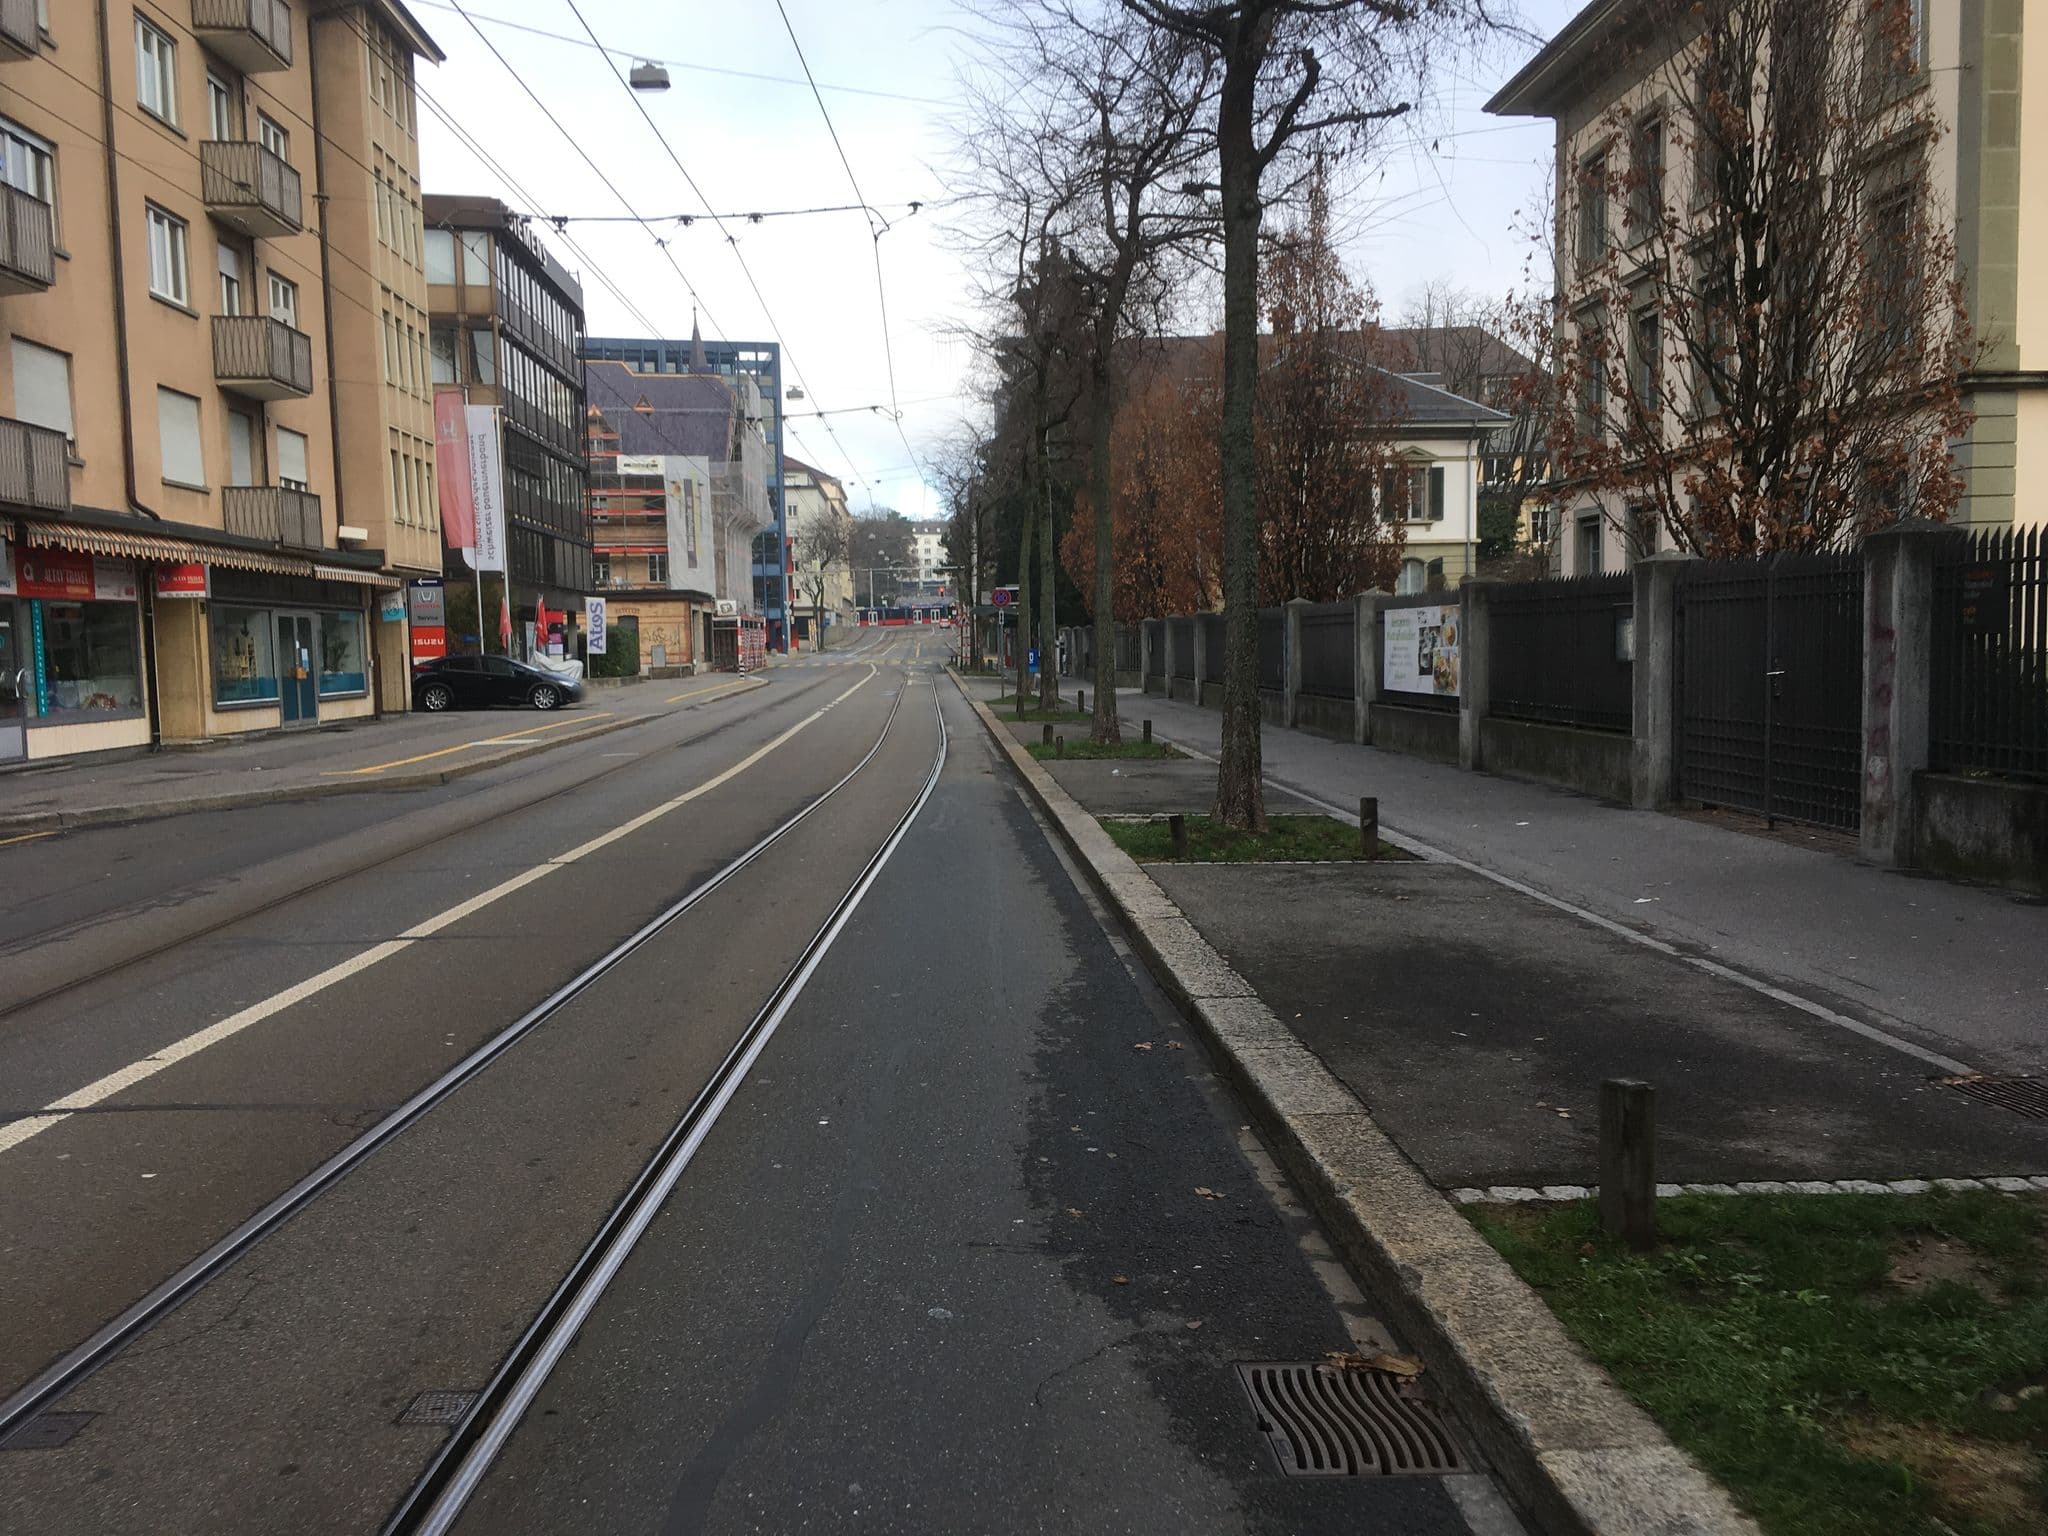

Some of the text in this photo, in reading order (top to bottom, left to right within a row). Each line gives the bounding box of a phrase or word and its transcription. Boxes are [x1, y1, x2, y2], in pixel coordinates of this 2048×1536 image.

[64, 570, 89, 585] TRAVEL
[589, 602, 603, 650] Atos
[413, 638, 444, 646] ISUZU
